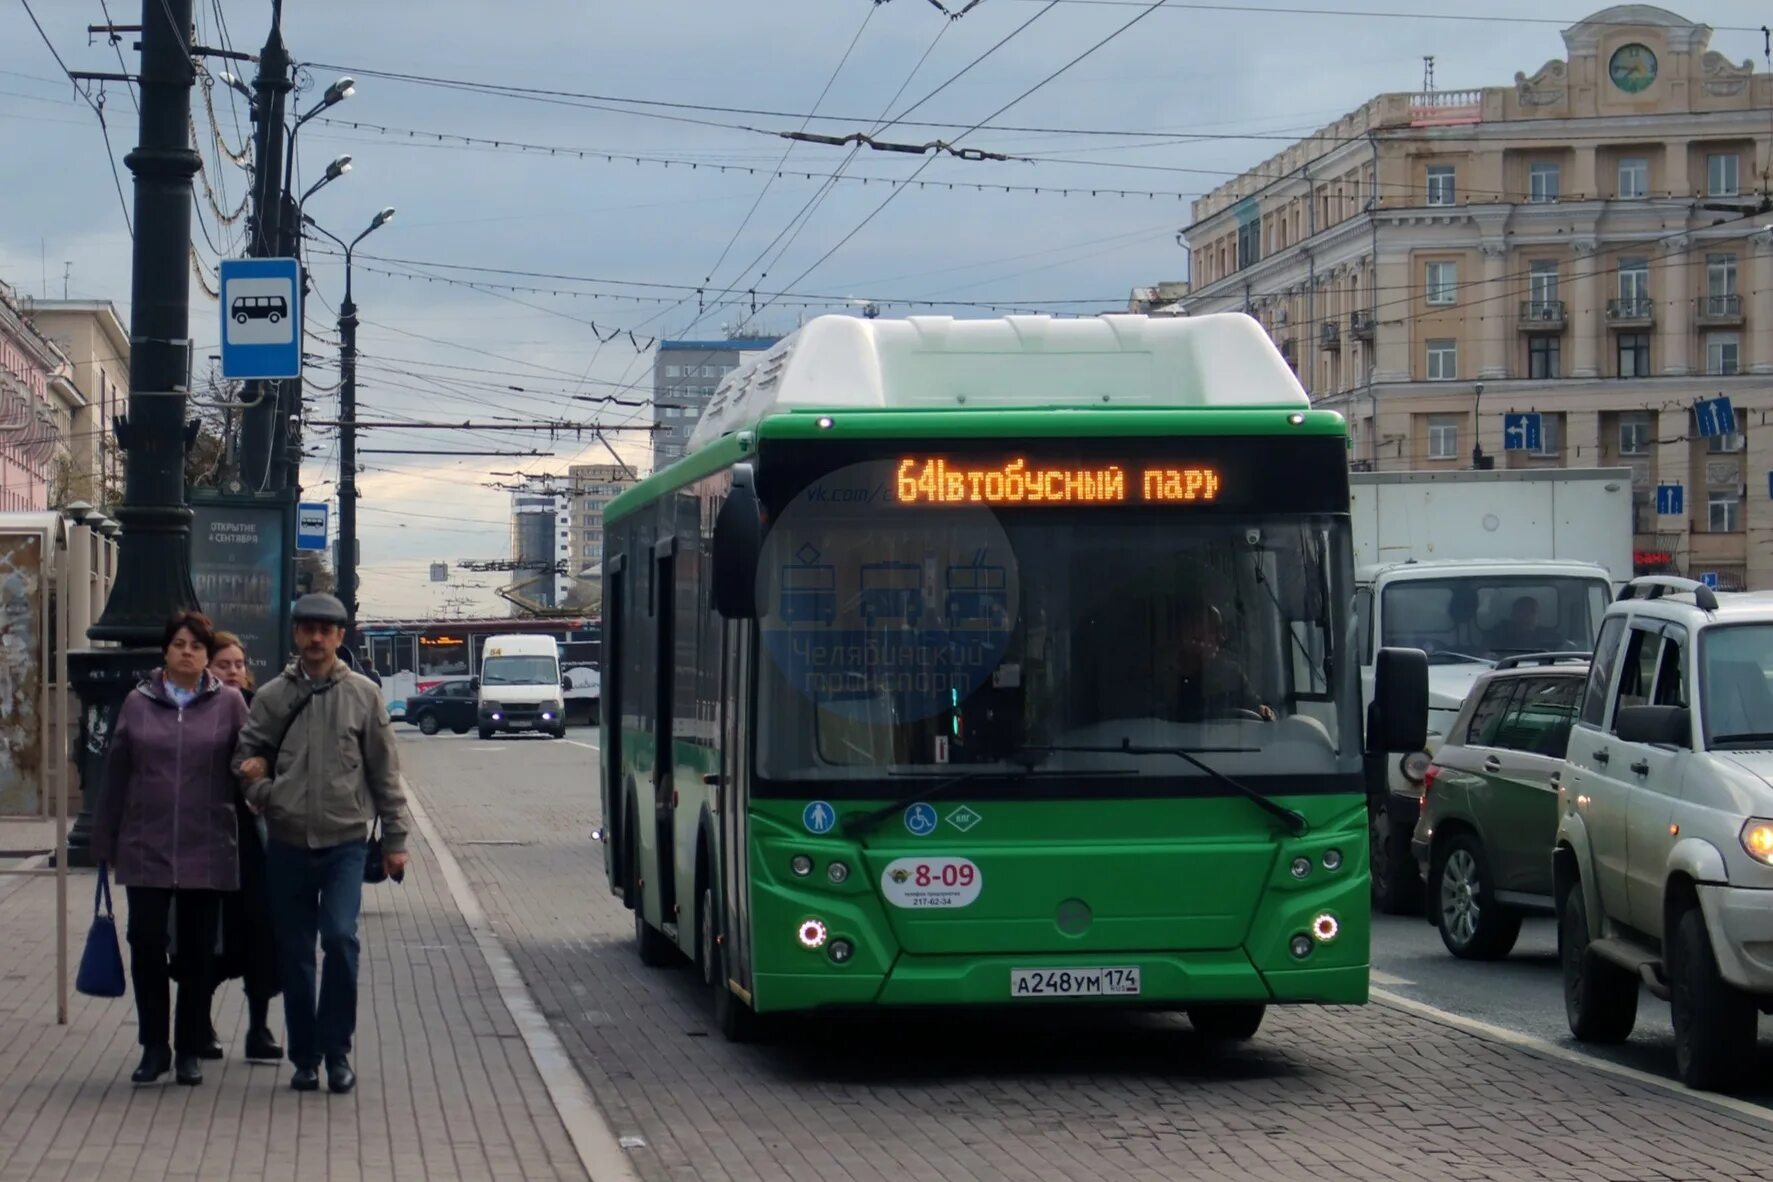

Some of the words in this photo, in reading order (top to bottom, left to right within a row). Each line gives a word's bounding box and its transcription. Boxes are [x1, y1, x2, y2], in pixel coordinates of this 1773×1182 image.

[210, 522, 256, 533] ОТКРЫТИЕ
[215, 533, 259, 545] СЕНТЯБРЯ
[915, 864, 974, 887] 8-09
[913, 897, 952, 906] 217-62-34
[1104, 970, 1136, 986] 174
